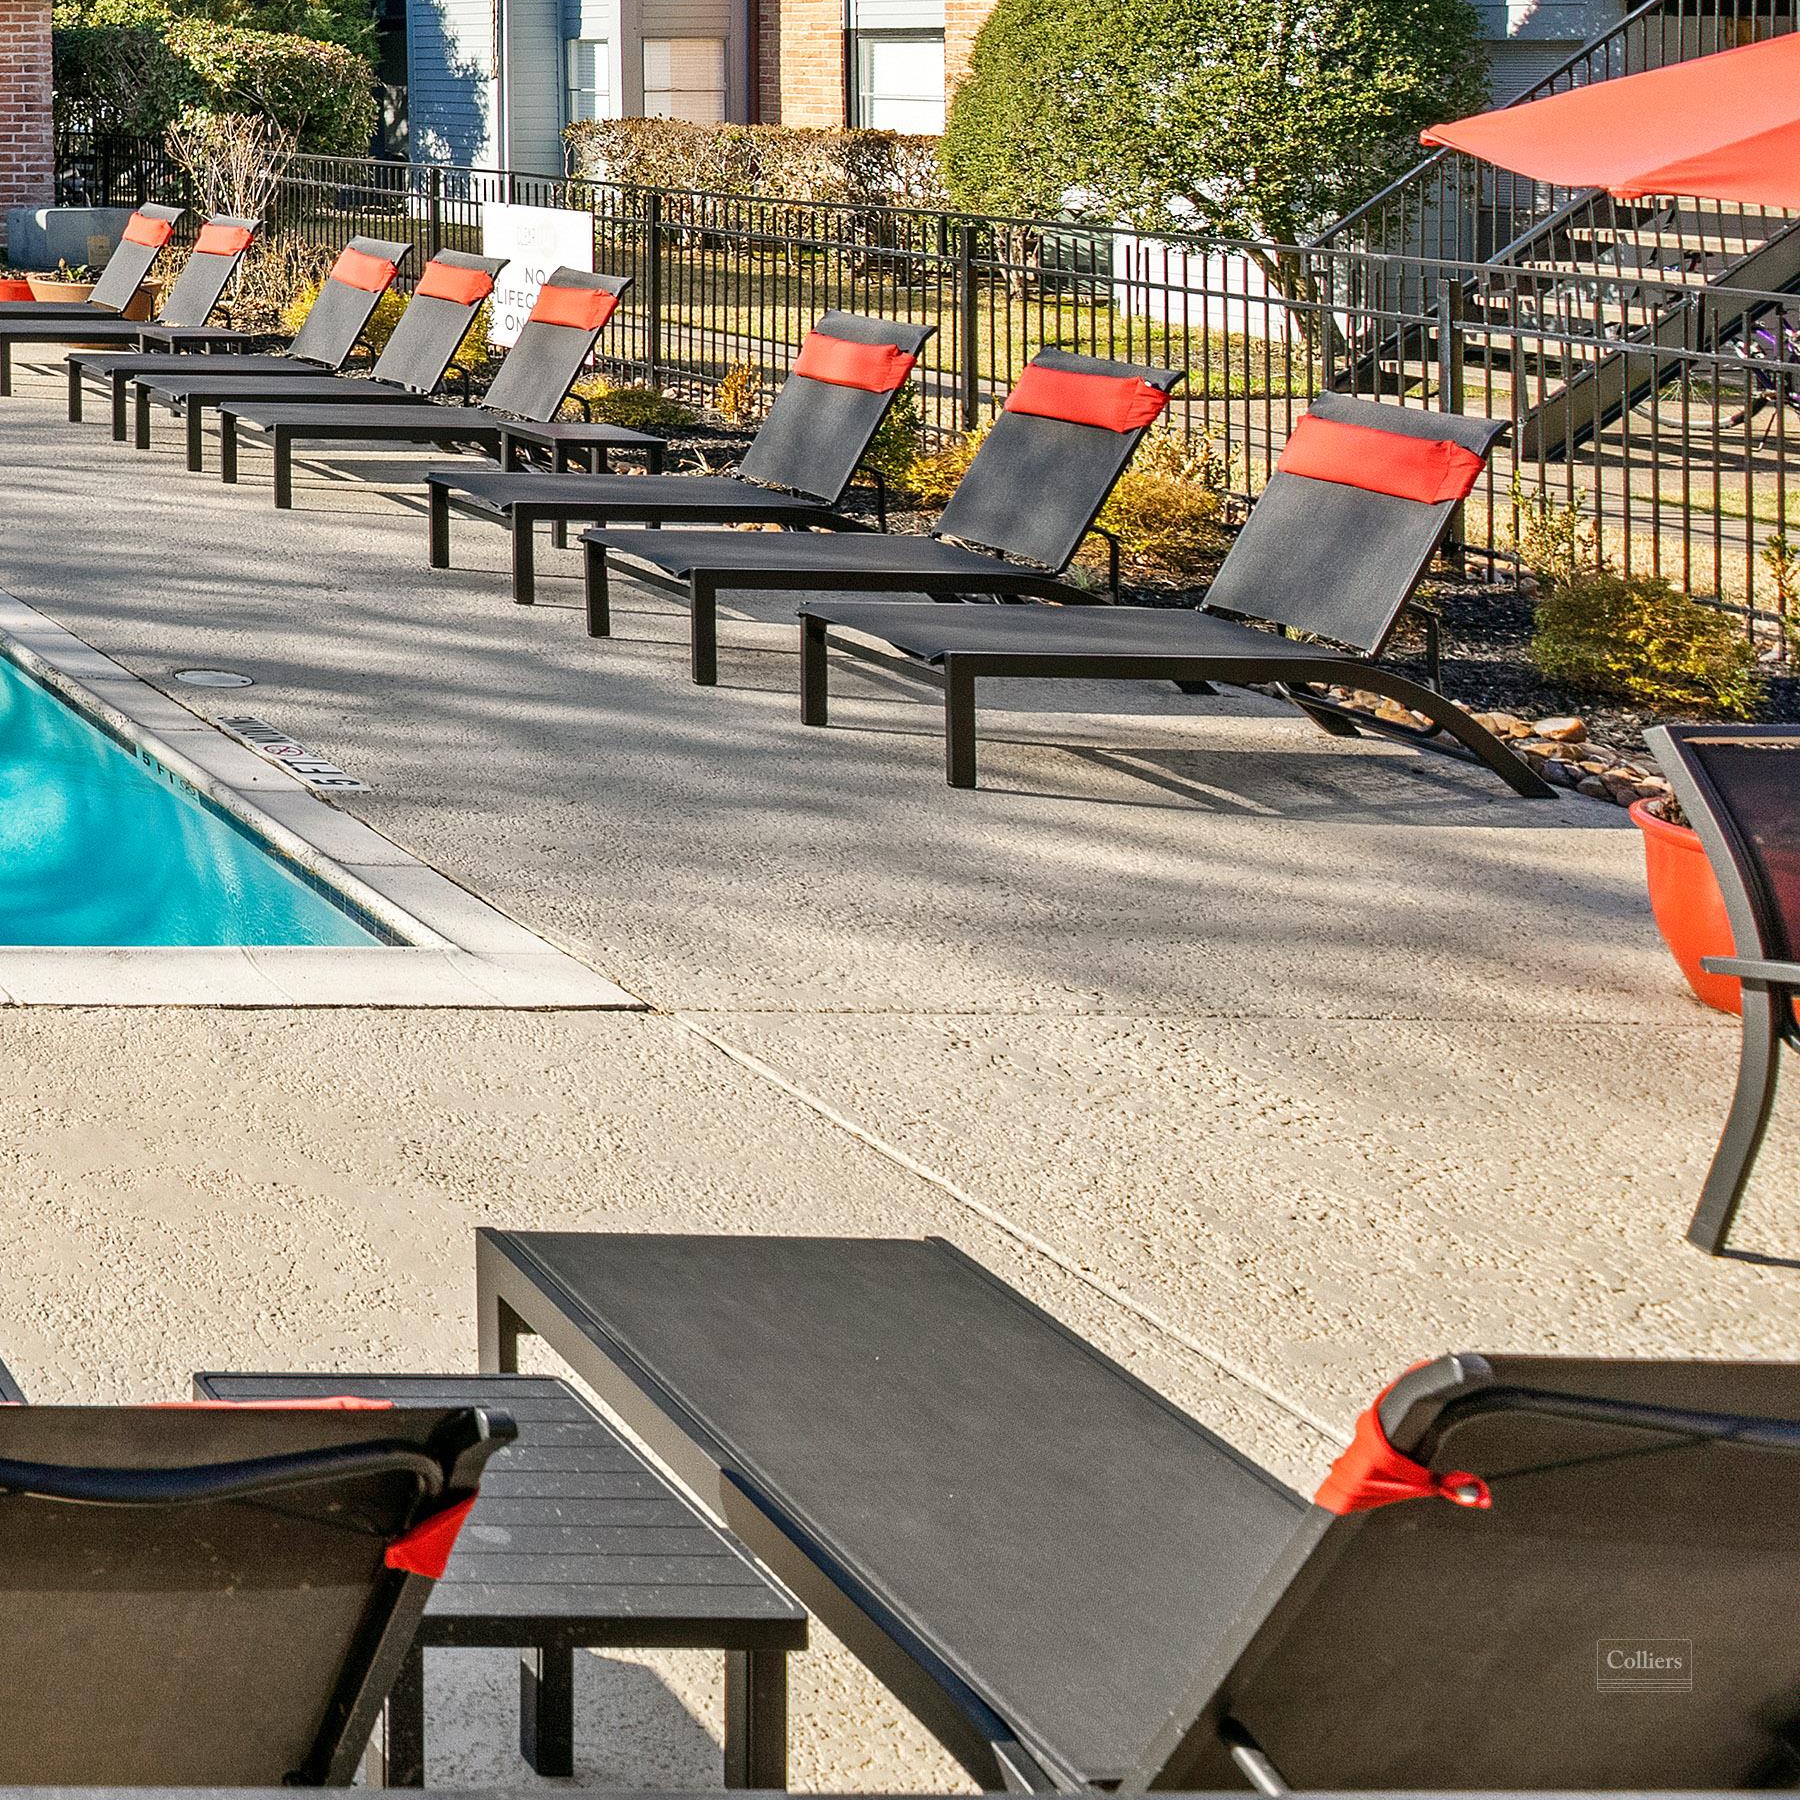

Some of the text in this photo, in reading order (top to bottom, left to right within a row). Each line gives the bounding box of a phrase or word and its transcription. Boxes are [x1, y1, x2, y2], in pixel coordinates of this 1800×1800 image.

[525, 267, 546, 286] NO
[496, 286, 535, 310] LIFEG
[505, 314, 525, 332] ON
[142, 751, 176, 784] 5 FT
[280, 759, 361, 786] 5 FT
